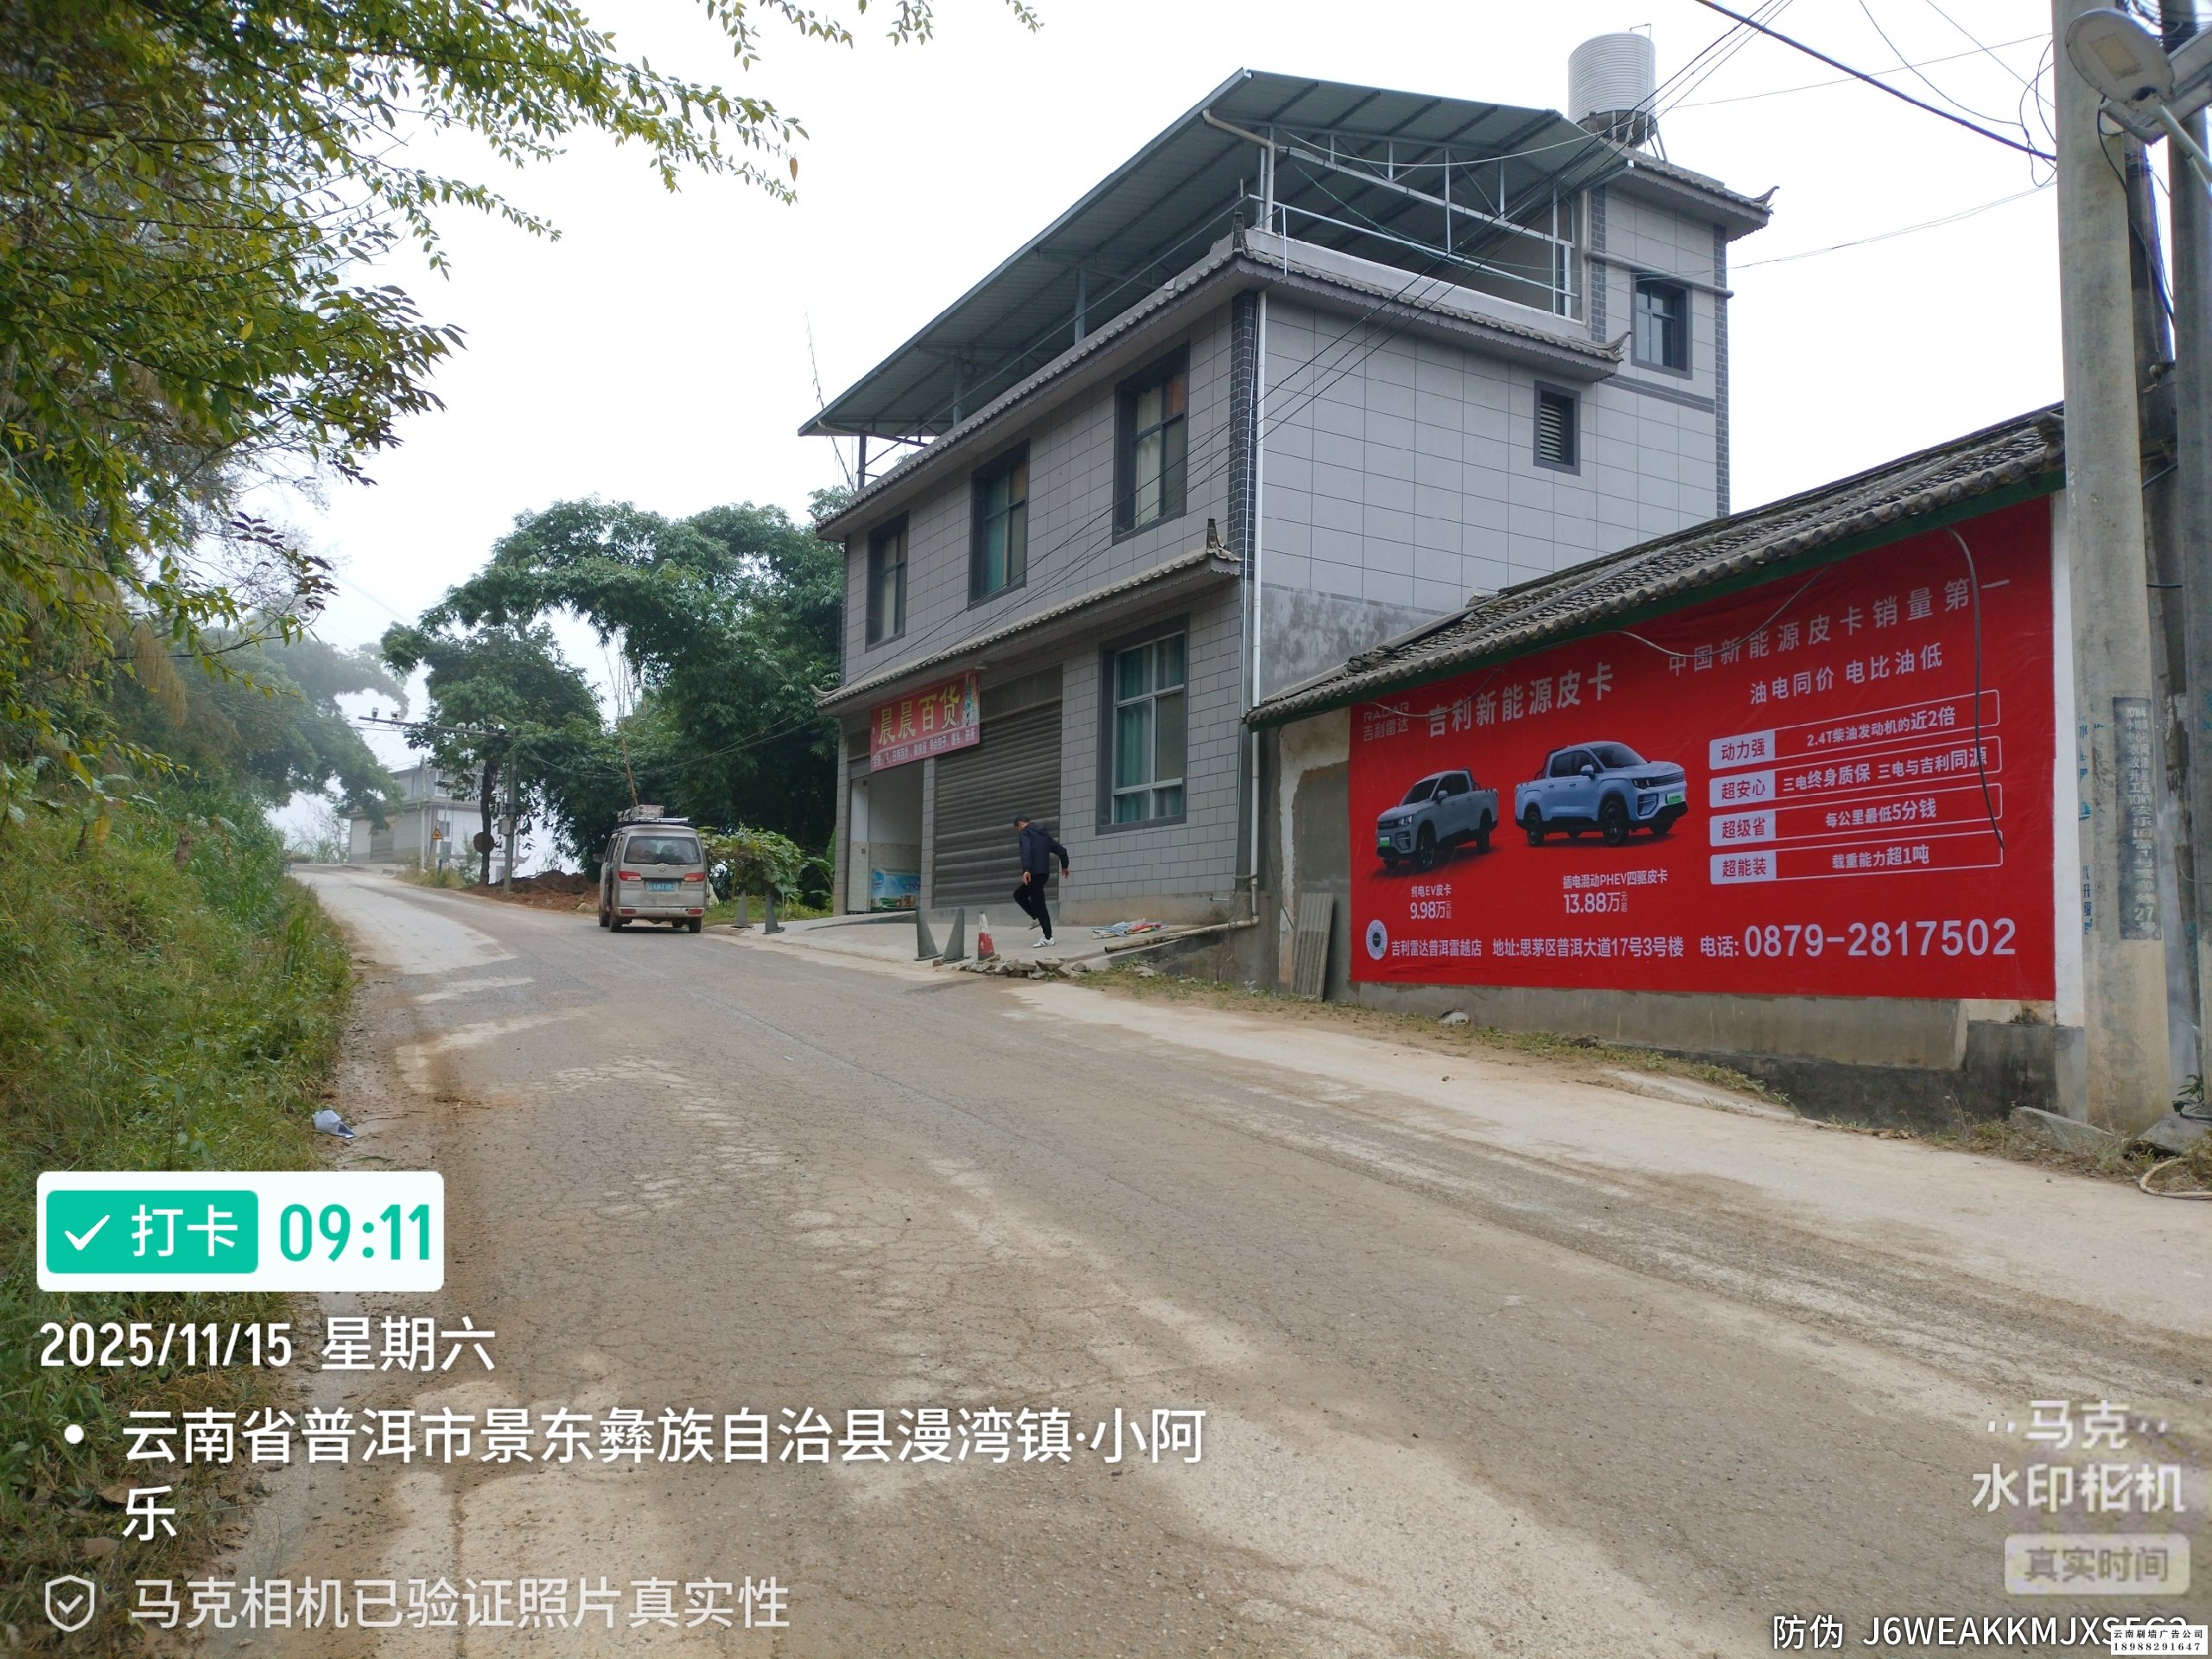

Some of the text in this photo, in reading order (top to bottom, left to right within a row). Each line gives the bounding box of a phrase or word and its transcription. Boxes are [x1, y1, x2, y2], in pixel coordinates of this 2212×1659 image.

[1669, 577, 2010, 677] 中国新能源皮卡销量第一
[1750, 642, 1942, 705] 油电同价 电比油低
[1429, 664, 1614, 737] 吉利新能源皮卡
[878, 685, 961, 746] 晨晨百货
[1807, 705, 1956, 747] 2.4T柴油发动机的近2倍
[1363, 716, 1409, 742] 吉利雷达
[1721, 739, 1765, 761] 动力强
[1783, 747, 1987, 792] 三电终身质保 三电与吉利同源
[1721, 779, 1766, 801] 超安心
[1825, 798, 1937, 828] 每公里最低5分钱
[1721, 816, 1766, 839] 超级省
[1722, 855, 1767, 878] 超能装
[1832, 843, 1930, 870] 载重能力超1吨
[1411, 883, 1452, 898] 纯电EV皮卡
[1562, 868, 1669, 889] 插电混动PHEV四驱皮卡
[1391, 938, 1483, 957] 吉利雷达普洱雷越店
[1492, 935, 1684, 958] 地址:思茅区普洱大道17号3号楼
